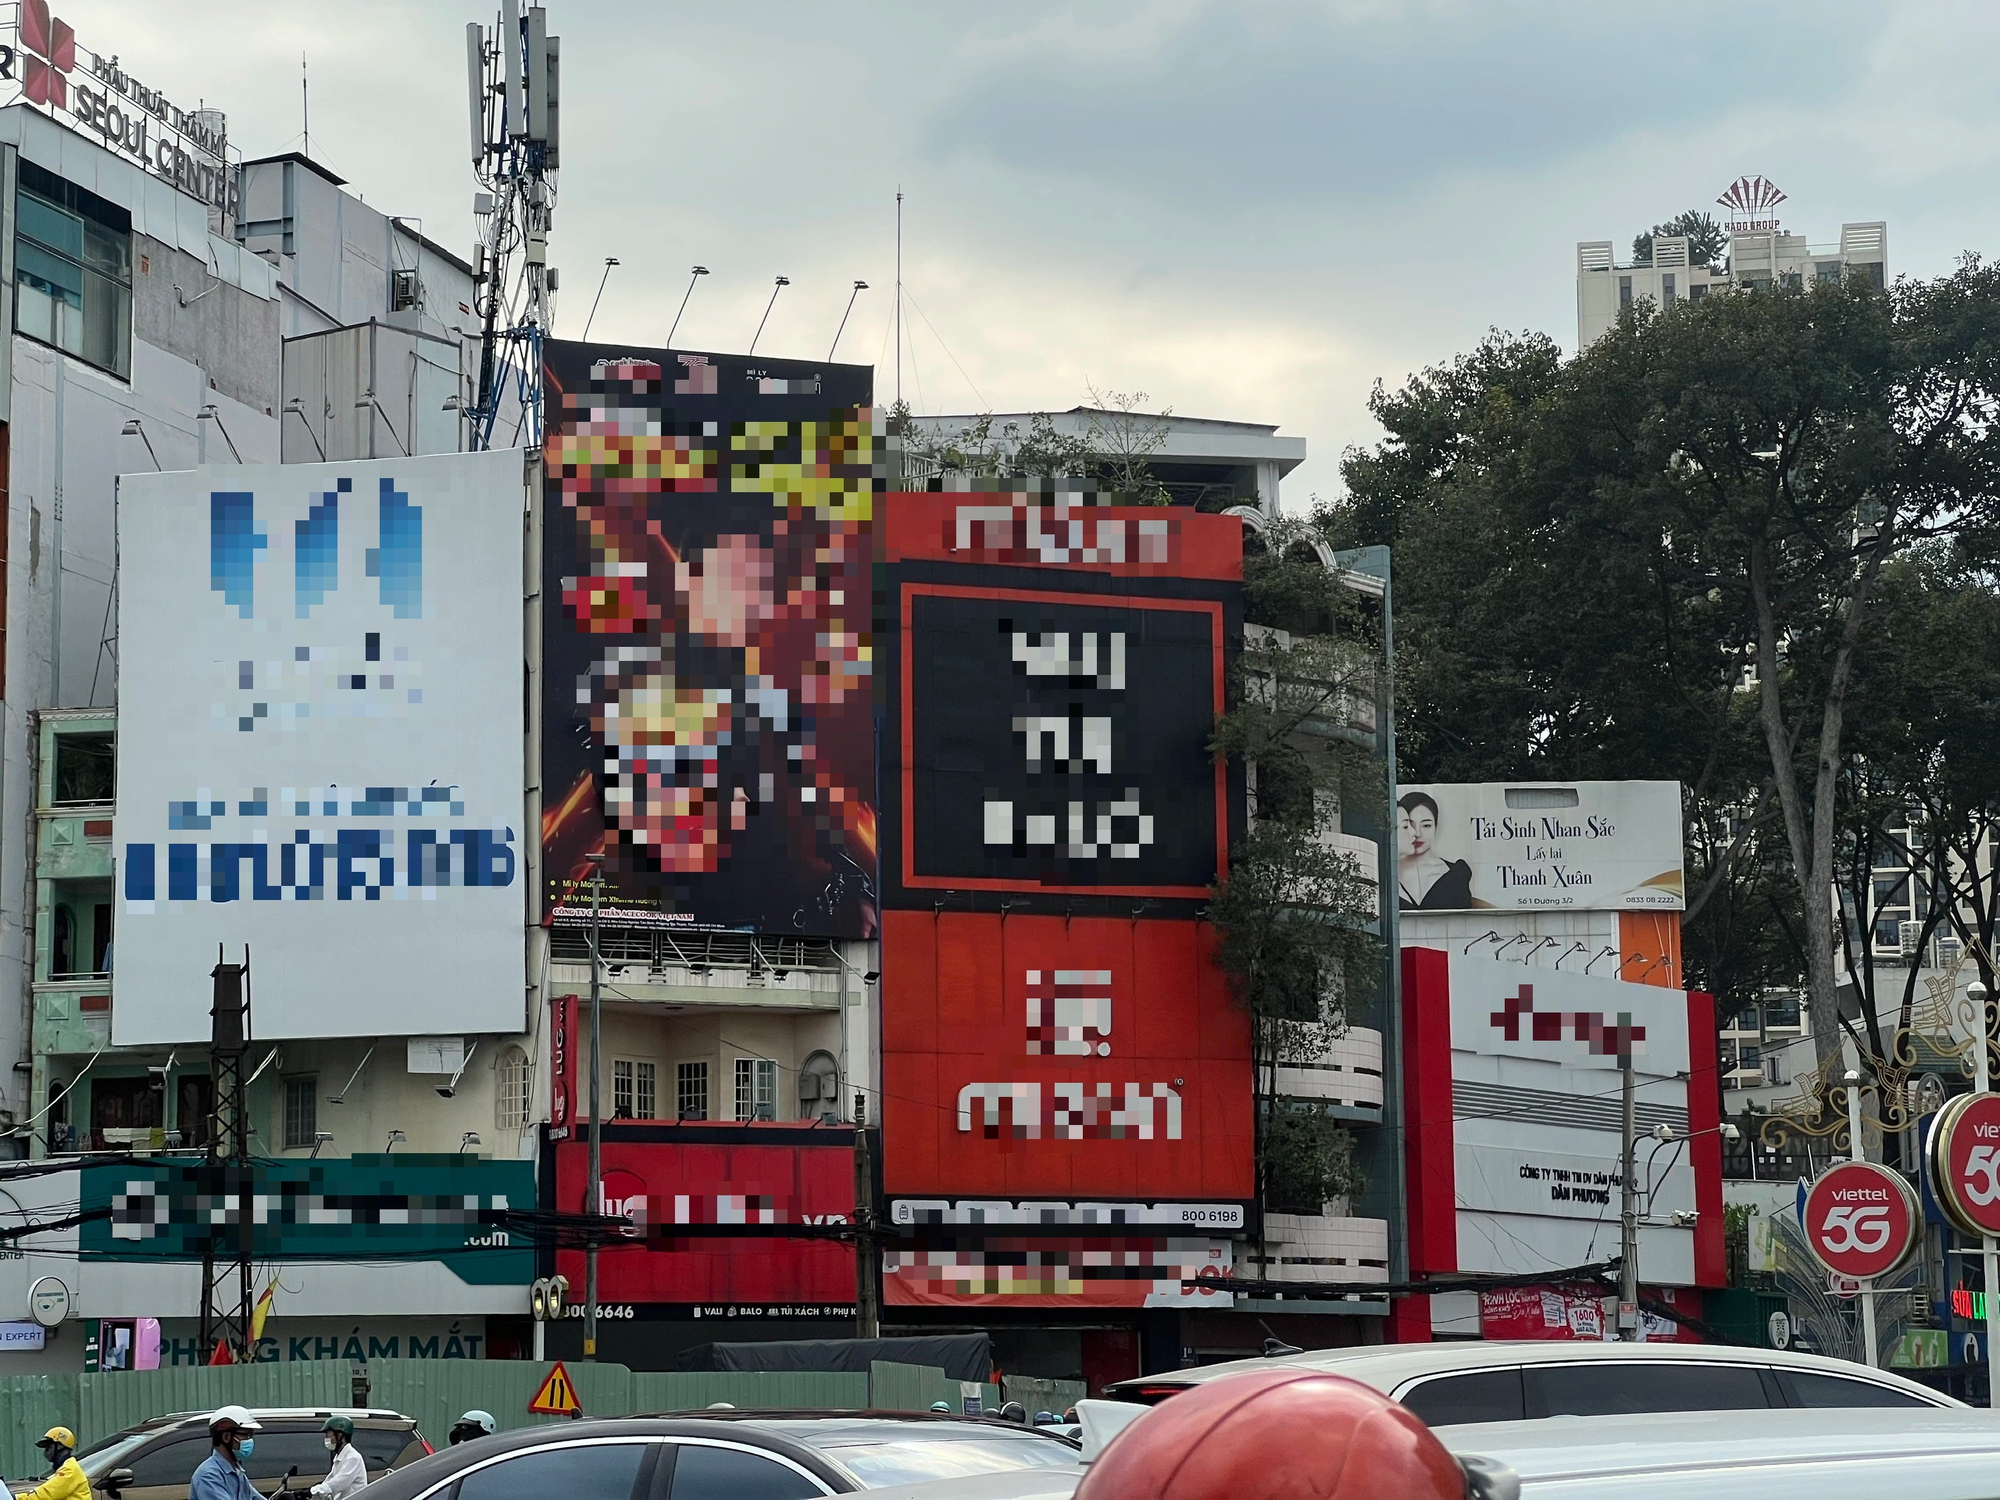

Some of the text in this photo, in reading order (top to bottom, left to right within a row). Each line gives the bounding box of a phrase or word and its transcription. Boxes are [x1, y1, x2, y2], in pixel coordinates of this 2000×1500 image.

[76, 84, 241, 220] SEOUL CENTER
[1724, 219, 1780, 232] HADO GROUP
[1470, 814, 1615, 840] Tái Sinh Nhan Sắc
[1526, 845, 1562, 862] Lấy lại
[1496, 865, 1592, 888] Thanh Xuân
[1625, 896, 1675, 904] 0833 08 2222
[586, 908, 593, 917] C
[1973, 1122, 2000, 1138] vie
[1541, 1168, 1551, 1180] TY
[1551, 1183, 1610, 1205] DÂN PHƯƠNG
[1831, 1188, 1889, 1201] viettel
[1208, 1211, 1238, 1222] 6198
[1821, 1206, 1891, 1254] 5G
[595, 1305, 634, 1319] 6646
[704, 1307, 723, 1316] VALI
[740, 1307, 763, 1316] BALO
[780, 1304, 820, 1316] TÚI XÁCH
[832, 1307, 849, 1318] PHỤ
[1574, 1309, 1594, 1322] 1600
[6, 1332, 42, 1341] EXPERT
[289, 1325, 399, 1363] KHÁM
[409, 1320, 483, 1361] MẮT
